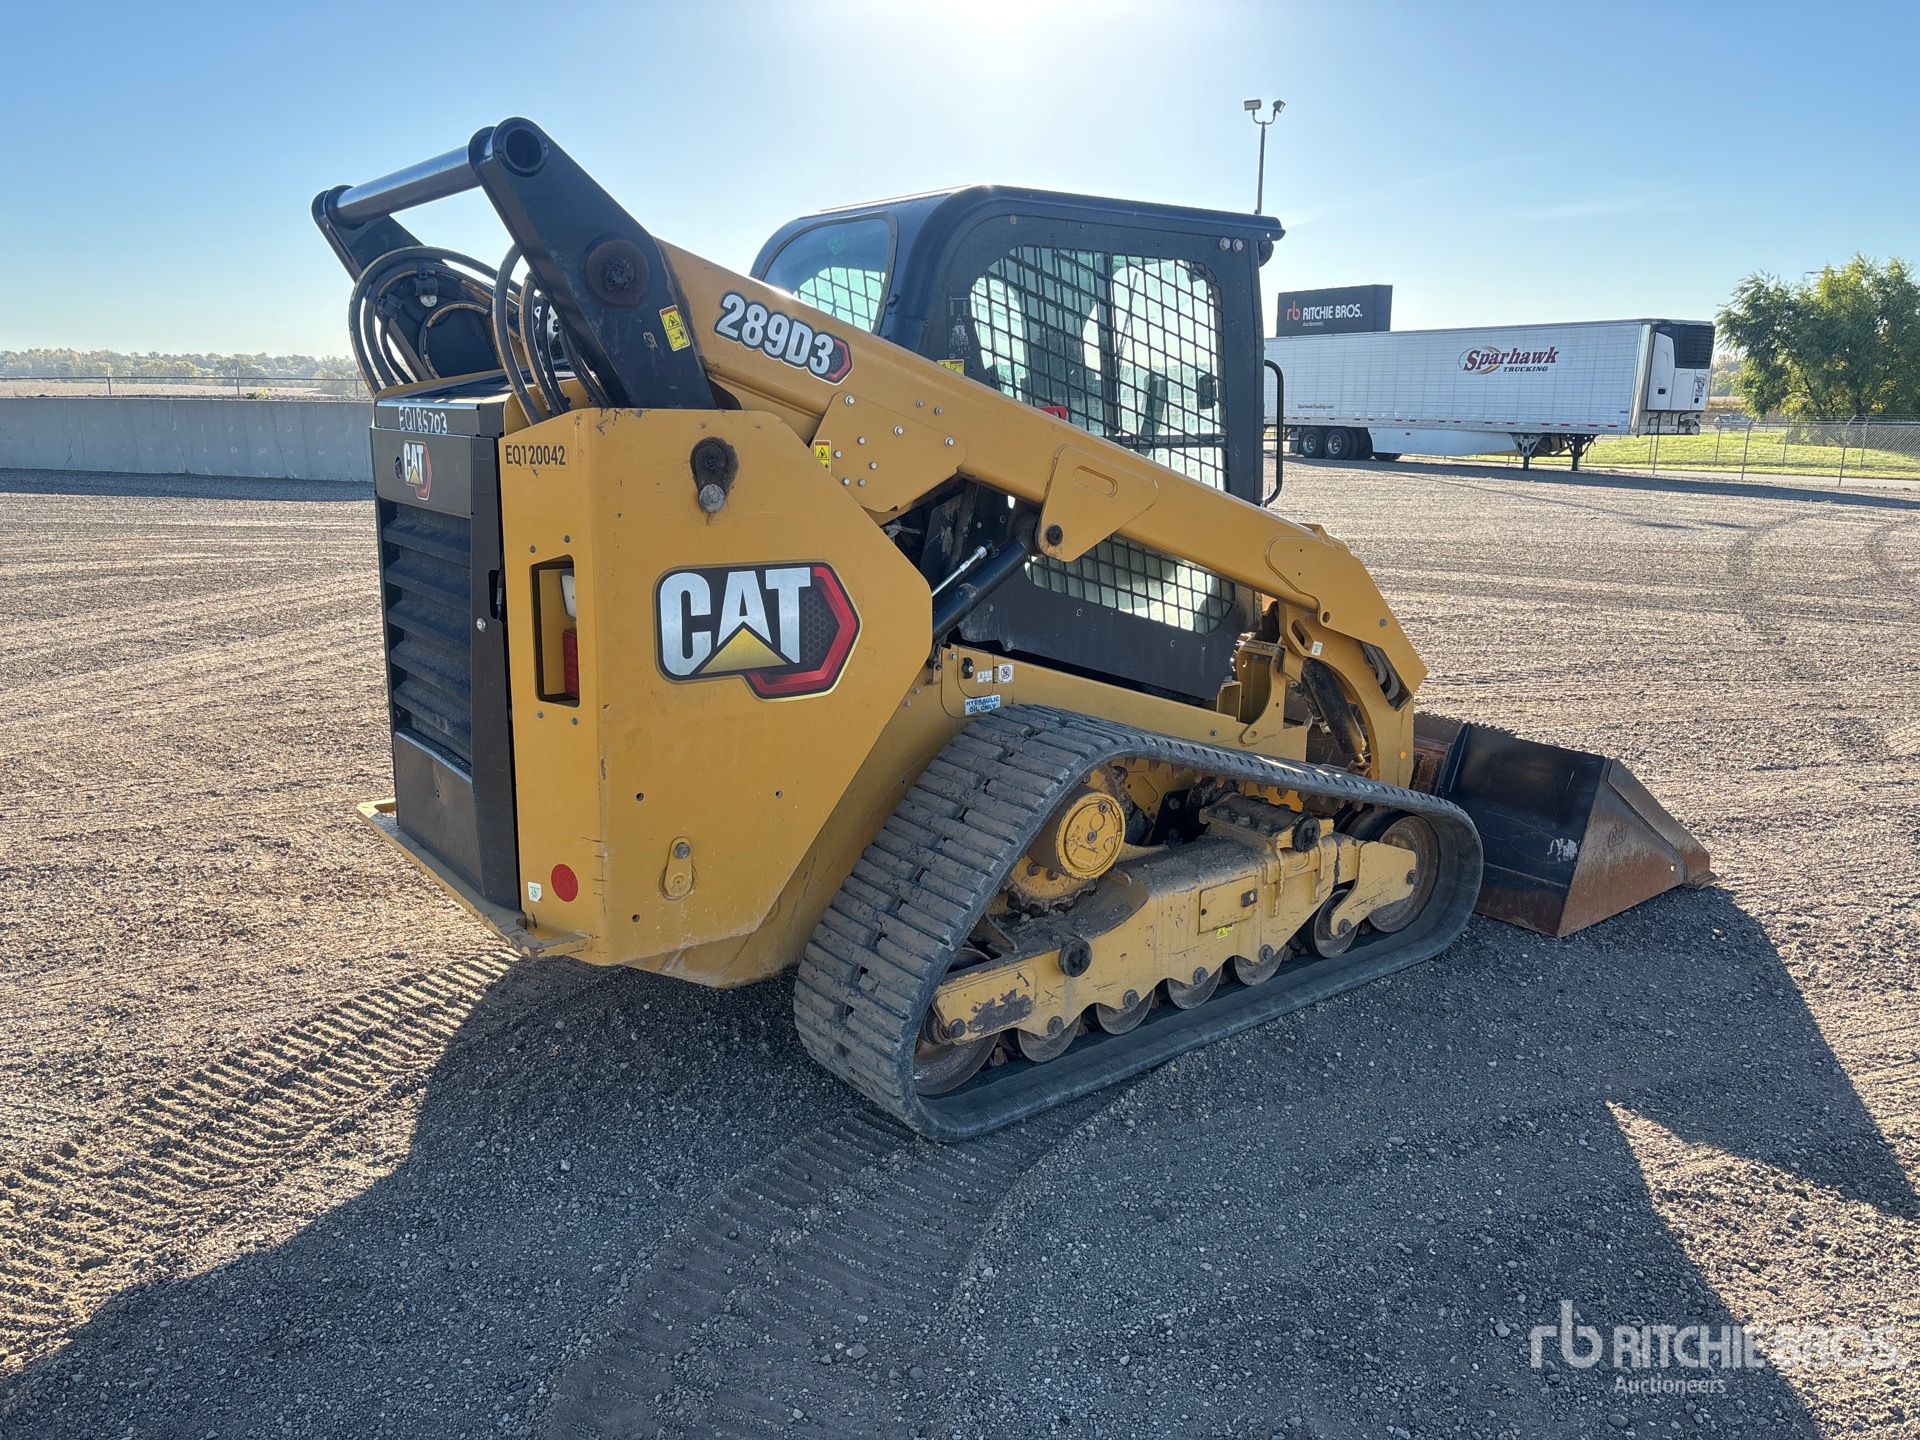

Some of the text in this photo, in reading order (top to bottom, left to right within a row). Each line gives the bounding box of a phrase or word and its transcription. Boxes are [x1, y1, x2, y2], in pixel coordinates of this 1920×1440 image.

[1286, 300, 1301, 321] rb
[1303, 303, 1363, 321] RITCHIE BROS.
[716, 293, 834, 375] 289D3
[1463, 346, 1559, 372] Sparhawk
[1503, 365, 1549, 373] TRUCKING
[403, 442, 424, 485] CAT
[505, 444, 566, 466] EQ120042
[660, 566, 811, 676] CAT
[966, 696, 999, 706] HYDRAULIC
[981, 703, 997, 711] ONLY
